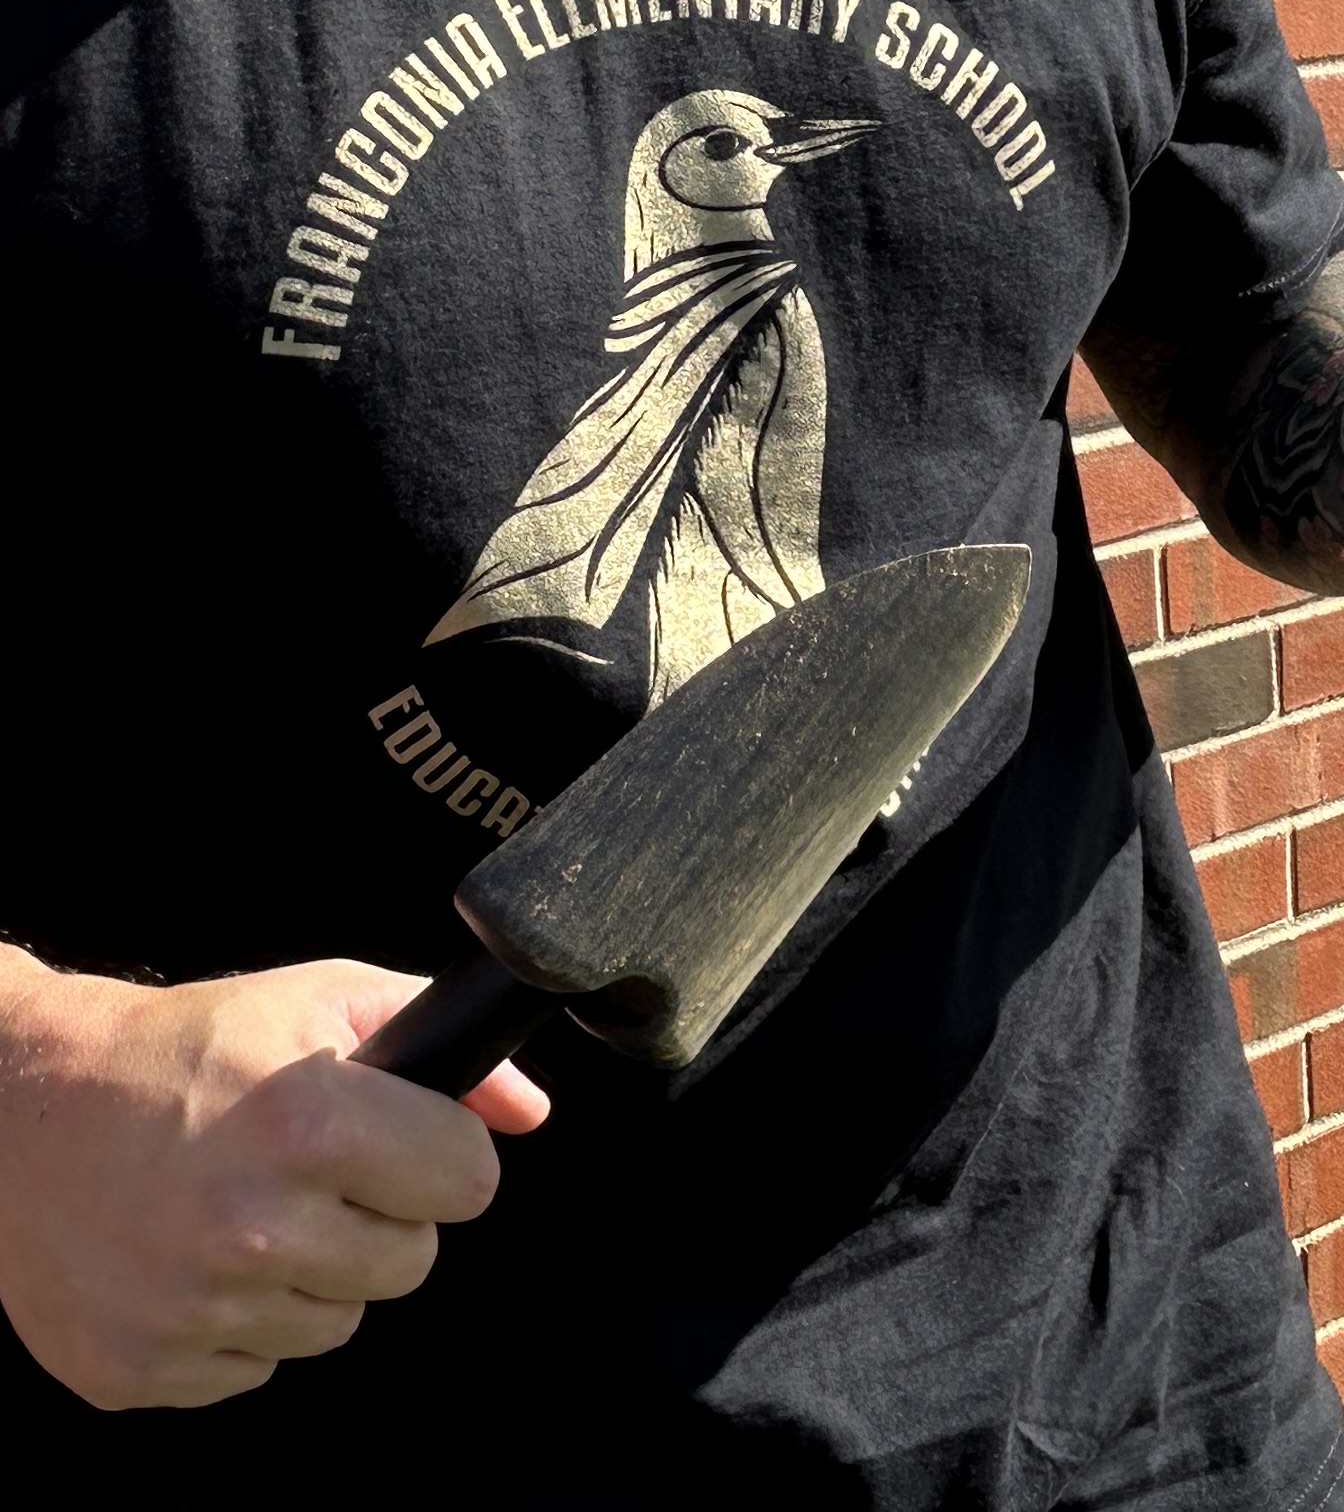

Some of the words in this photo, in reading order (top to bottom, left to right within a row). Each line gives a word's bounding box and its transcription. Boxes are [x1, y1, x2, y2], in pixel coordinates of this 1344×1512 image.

[261, 12, 508, 362] FRANCONIA
[875, 0, 1057, 212] SCHOOL
[368, 685, 543, 838] EDUCA
